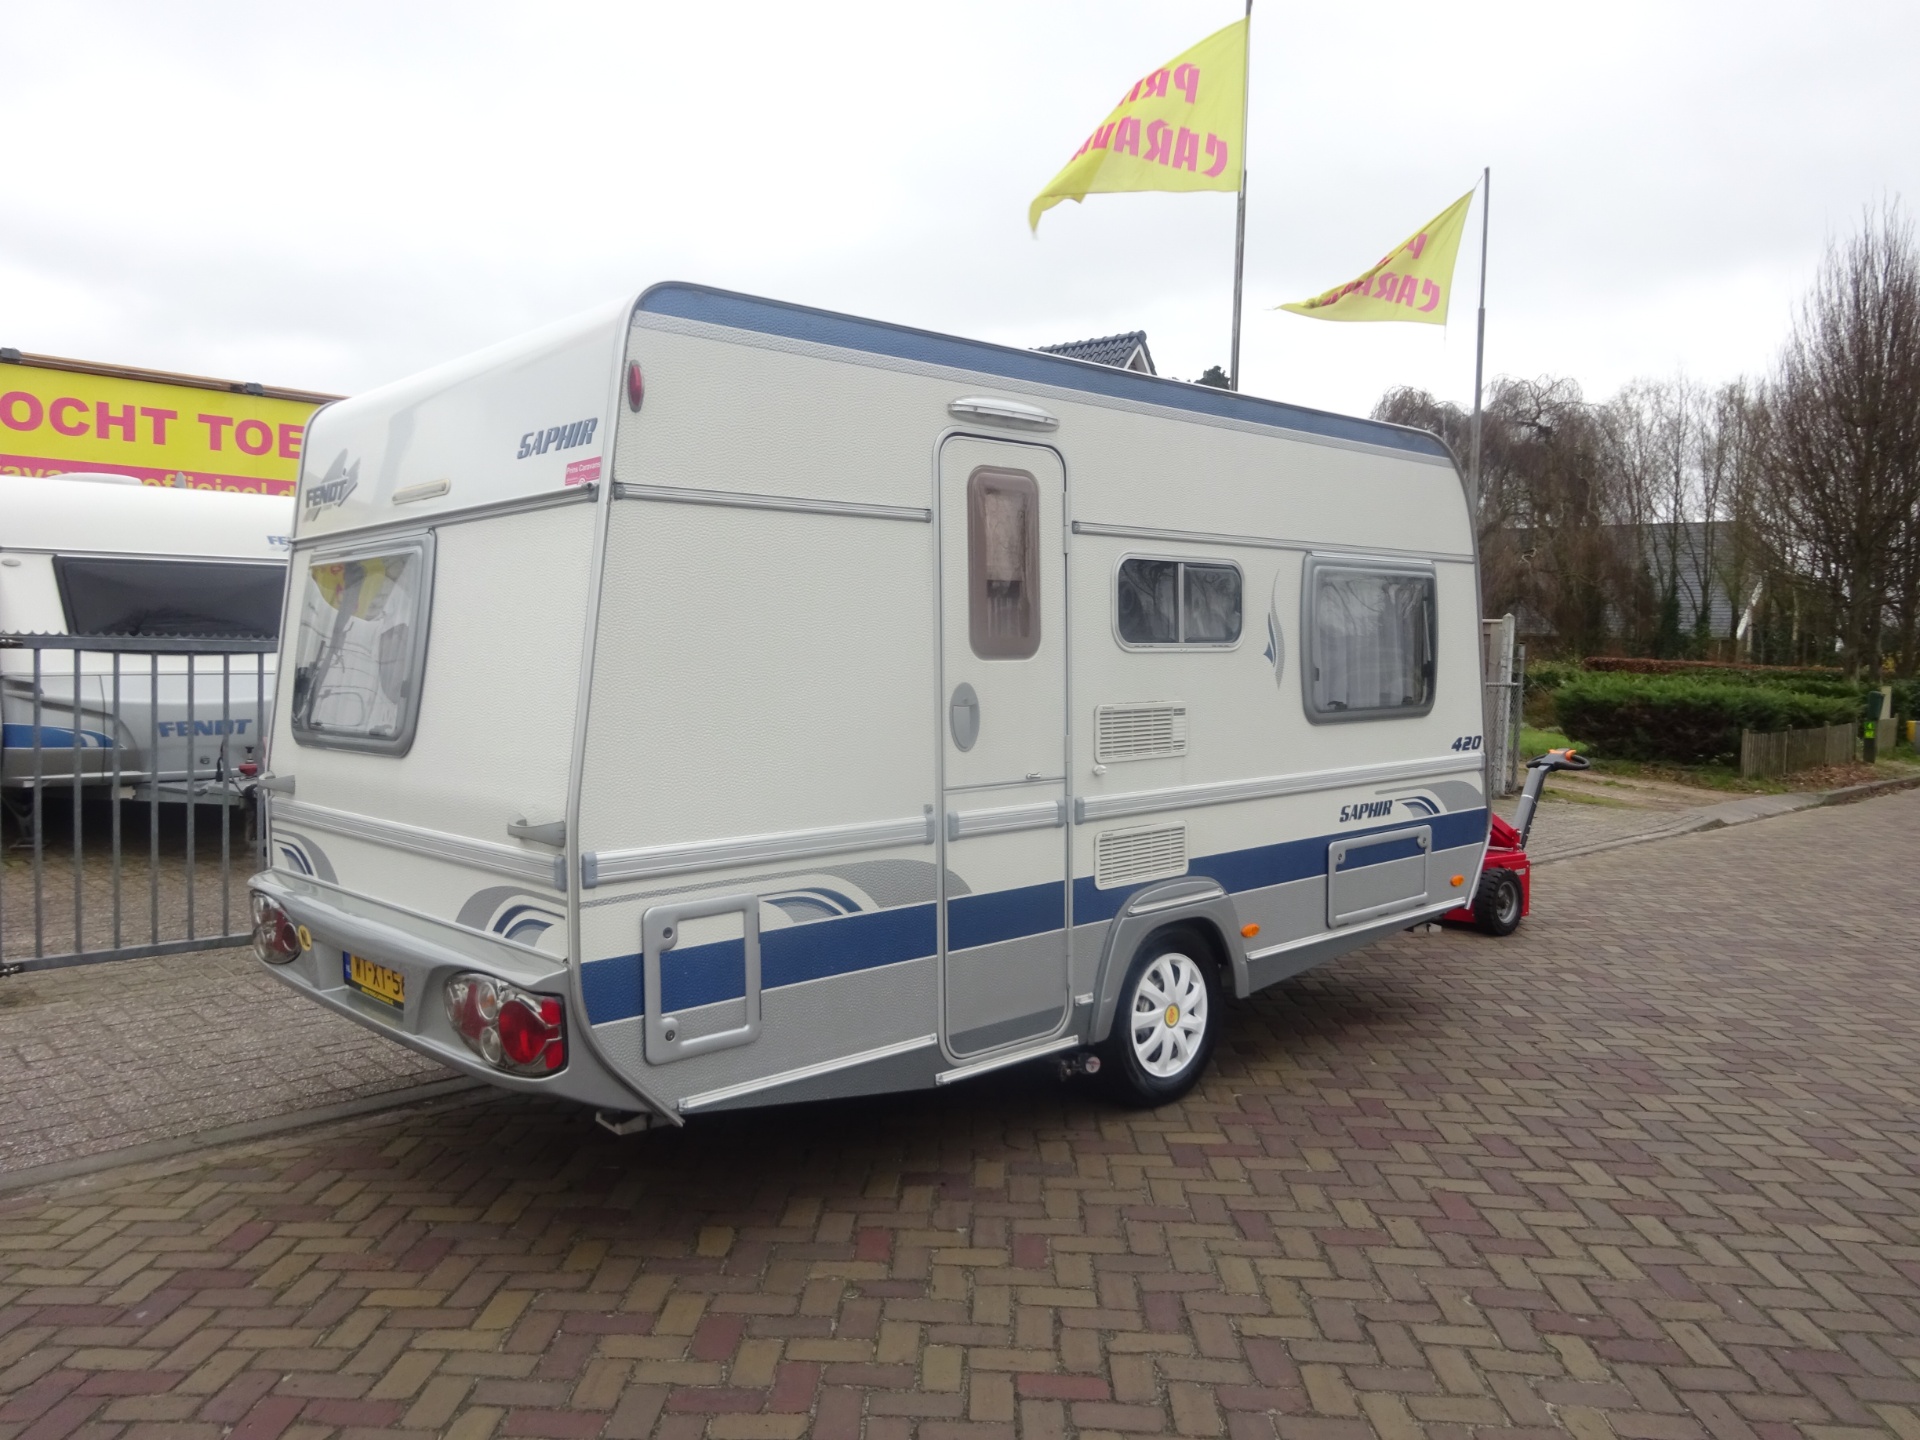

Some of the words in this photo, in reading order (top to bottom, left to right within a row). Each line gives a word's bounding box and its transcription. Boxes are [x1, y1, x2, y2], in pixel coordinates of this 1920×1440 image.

[516, 417, 599, 460] SAPHIR
[305, 479, 349, 509] FENDT
[158, 719, 253, 737] FENDT
[1451, 735, 1483, 752] 420
[1339, 800, 1393, 823] SAPHIR
